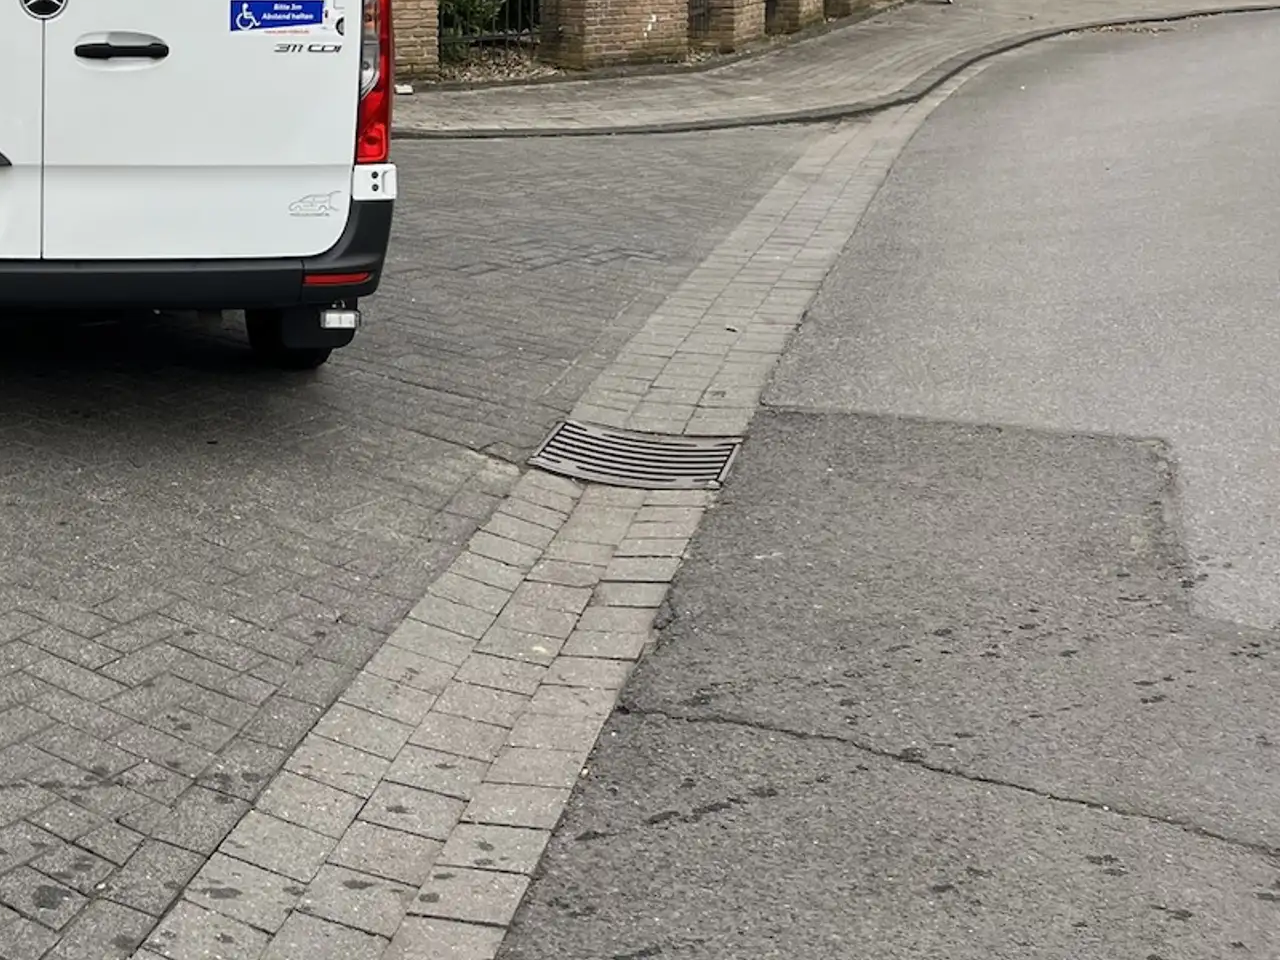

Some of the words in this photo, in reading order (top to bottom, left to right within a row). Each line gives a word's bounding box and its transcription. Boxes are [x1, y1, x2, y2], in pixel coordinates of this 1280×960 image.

[261, 12, 291, 20] Abstand
[292, 12, 314, 20] halten
[274, 43, 304, 52] 311
[307, 43, 342, 53] CDI
